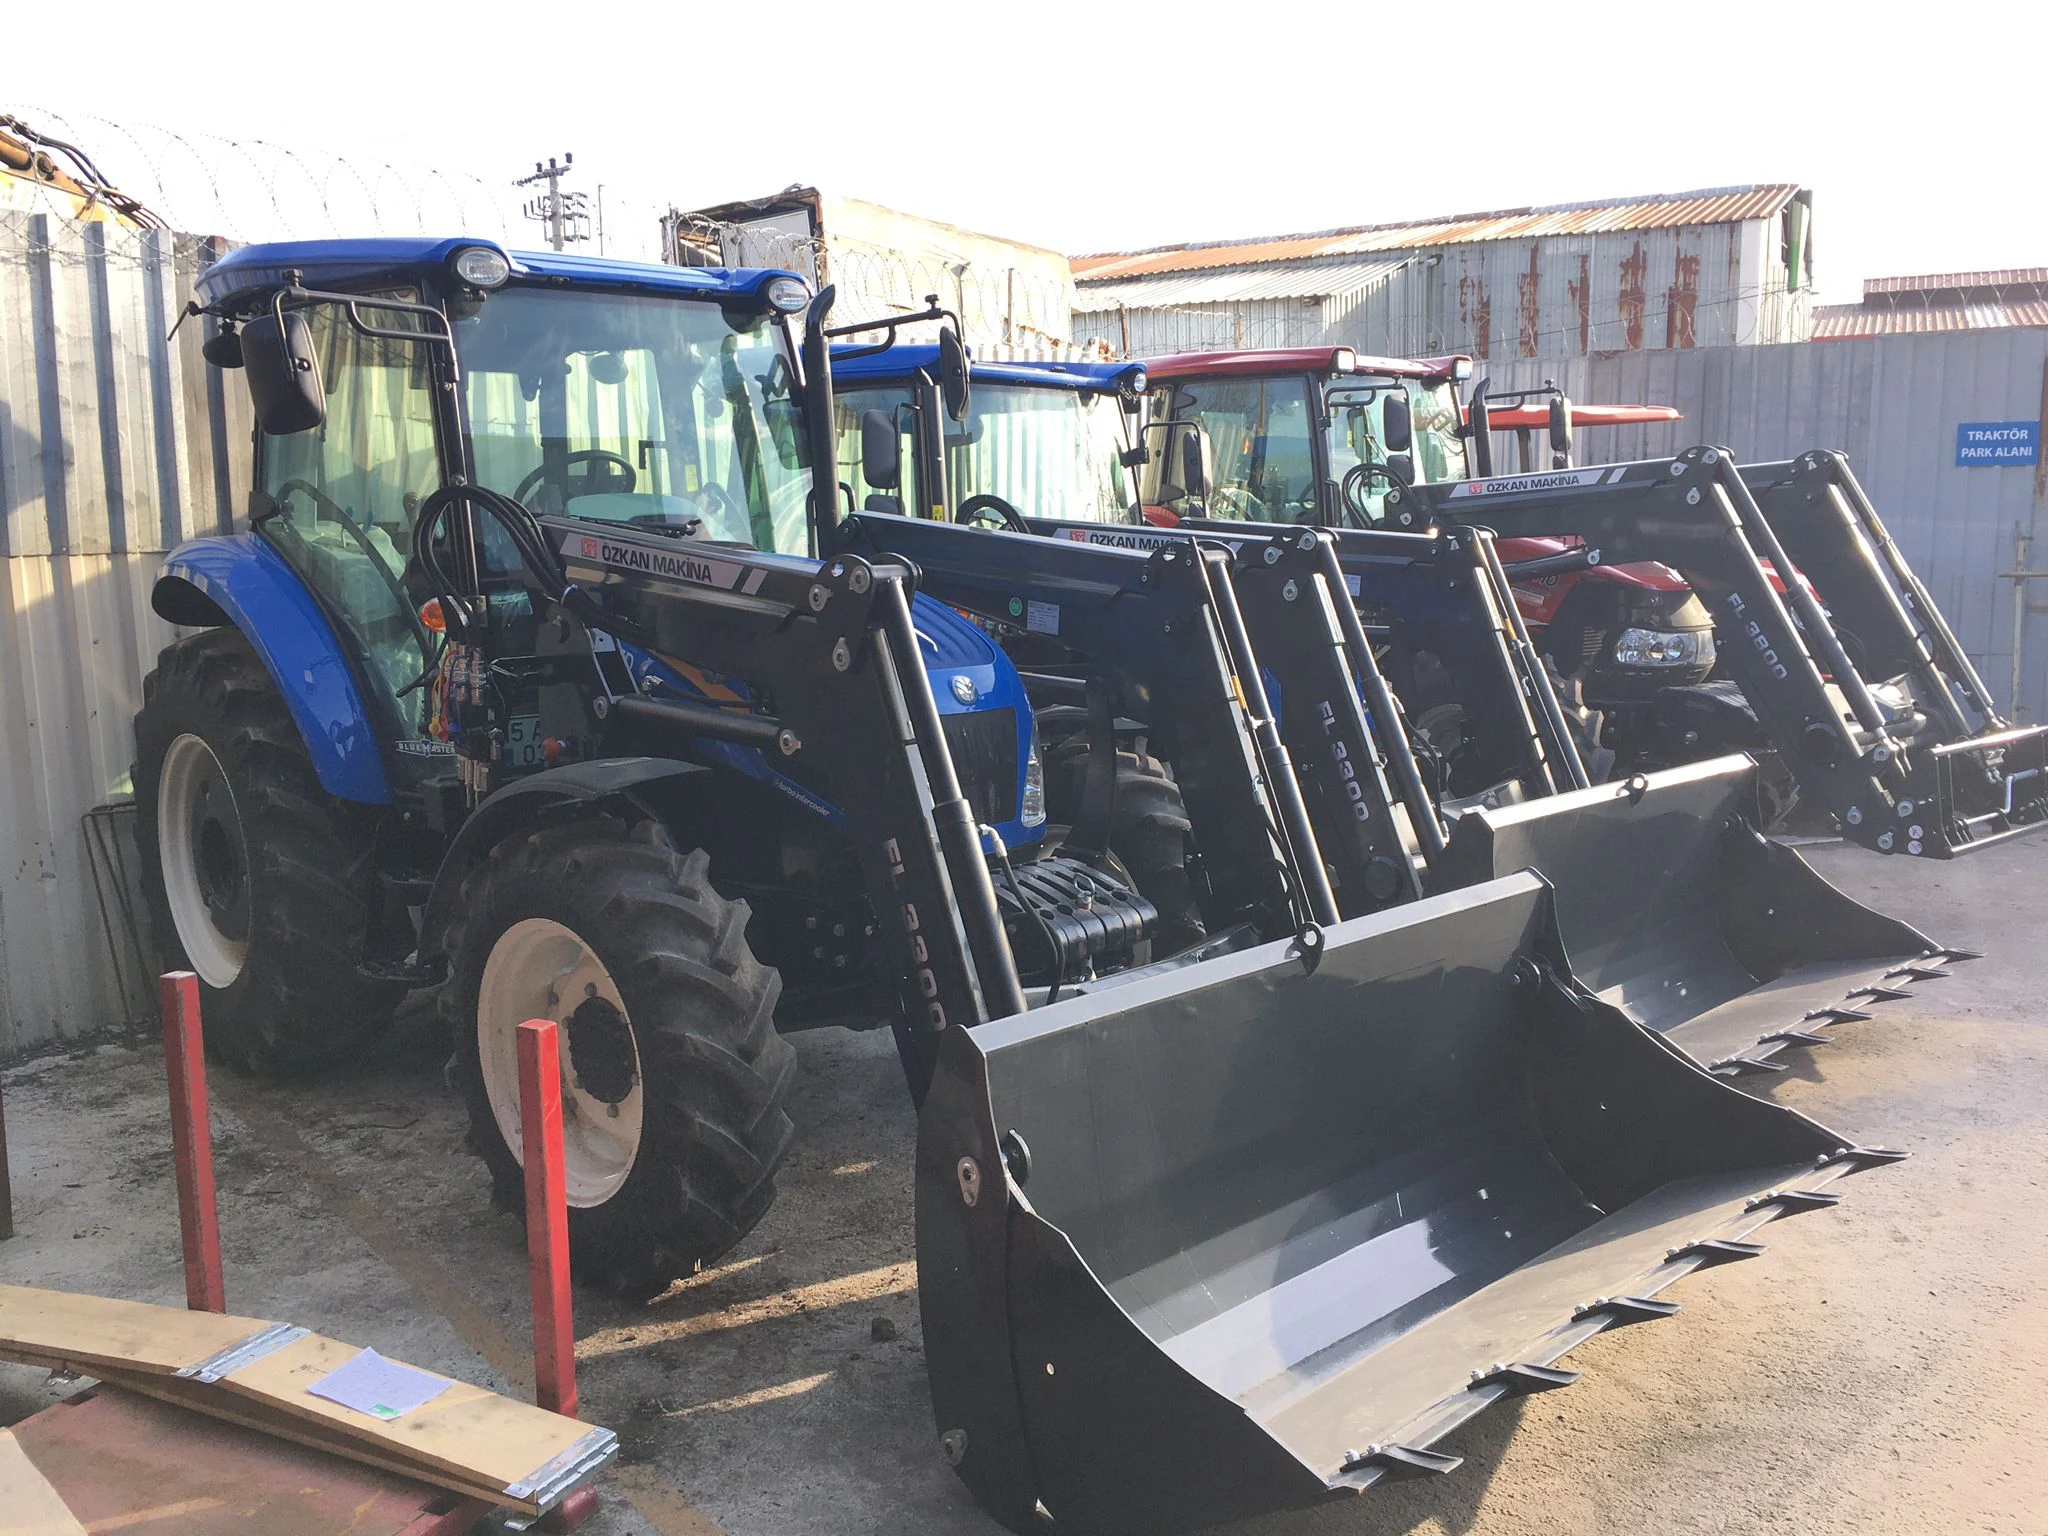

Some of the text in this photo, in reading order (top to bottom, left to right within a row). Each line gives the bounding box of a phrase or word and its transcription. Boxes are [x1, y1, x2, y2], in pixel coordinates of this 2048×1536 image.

[1967, 427, 2029, 441] TRAKTÖR
[1961, 446, 2033, 458] PARK ALANI
[1486, 474, 1580, 493] ÖZKAN MAKİNA
[1089, 531, 1136, 549] ÖZKAN
[601, 542, 713, 584] ÖZKAN MAKİNA
[1727, 592, 1746, 619] FL
[1316, 700, 1370, 822] FL 3300
[778, 781, 796, 797] turbo
[883, 837, 947, 1032] FL 3300
